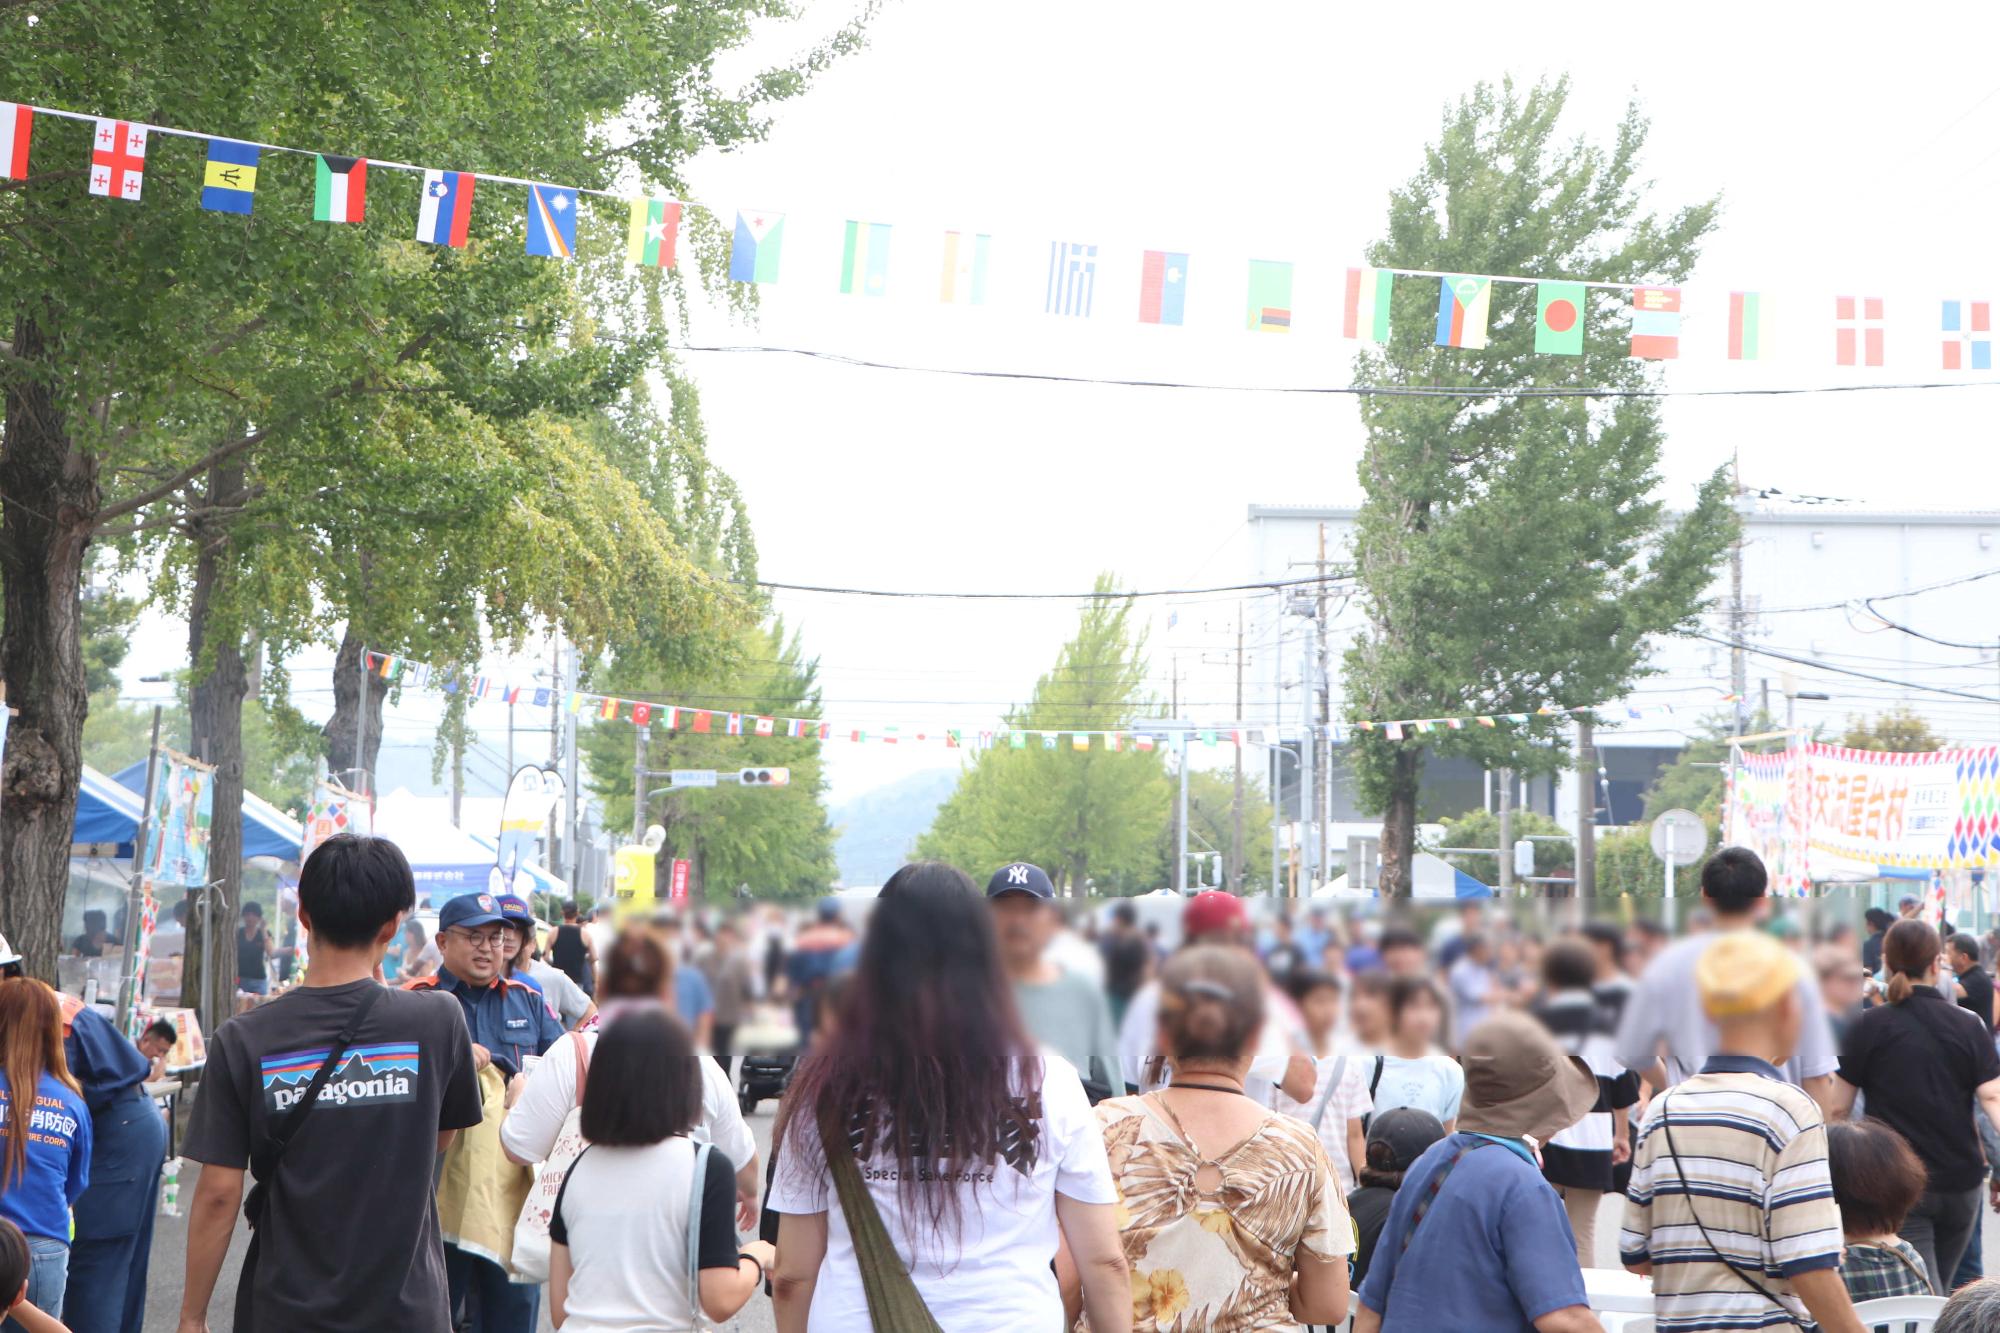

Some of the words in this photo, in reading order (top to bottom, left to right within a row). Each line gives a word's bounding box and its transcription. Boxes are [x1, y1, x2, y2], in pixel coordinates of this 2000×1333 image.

[1007, 866, 1029, 884] NY
[273, 1073, 410, 1111] paagonia
[541, 1171, 567, 1185] MICK
